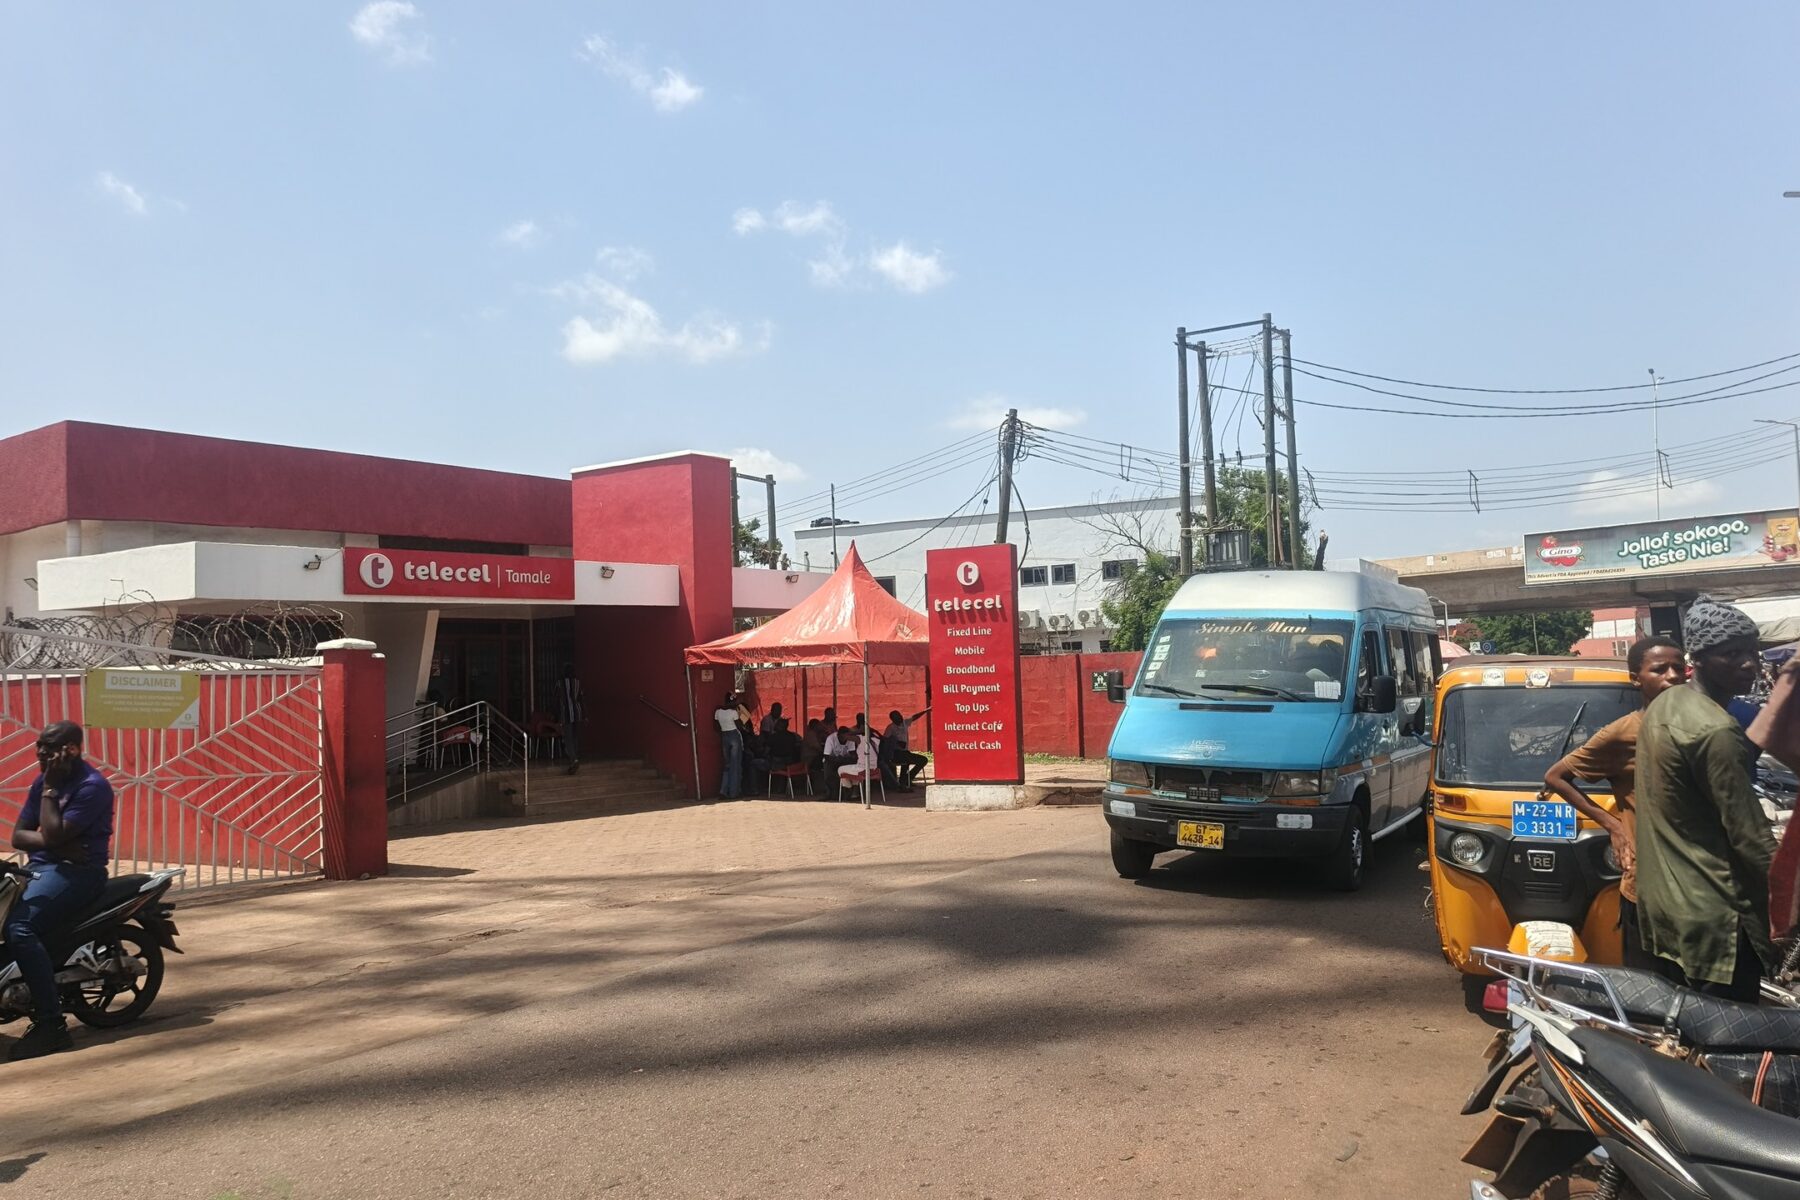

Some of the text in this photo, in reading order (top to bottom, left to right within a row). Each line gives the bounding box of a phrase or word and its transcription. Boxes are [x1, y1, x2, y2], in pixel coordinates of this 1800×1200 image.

[1618, 520, 1750, 556] Jollof sokooo,
[1549, 548, 1573, 556] Gino
[1639, 537, 1729, 569] Taste Nie!
[404, 561, 491, 583] telecel
[505, 569, 551, 584] Tamale
[934, 594, 1002, 612] telecel
[947, 626, 992, 637] Fixed Line
[1195, 621, 1307, 634] Simple Man
[954, 645, 985, 655] Mobile
[946, 664, 996, 675] Broadband
[111, 676, 177, 687] DISCLAIMER
[943, 683, 1001, 695] Bill Payment
[955, 702, 990, 714] Top Ups
[944, 720, 1003, 733] Internet Café
[946, 740, 1002, 750] Telecel Cash
[1195, 824, 1207, 834] GT
[1531, 821, 1562, 835] 3331
[1181, 833, 1220, 845] 4438-14
[1533, 857, 1551, 867] RE
